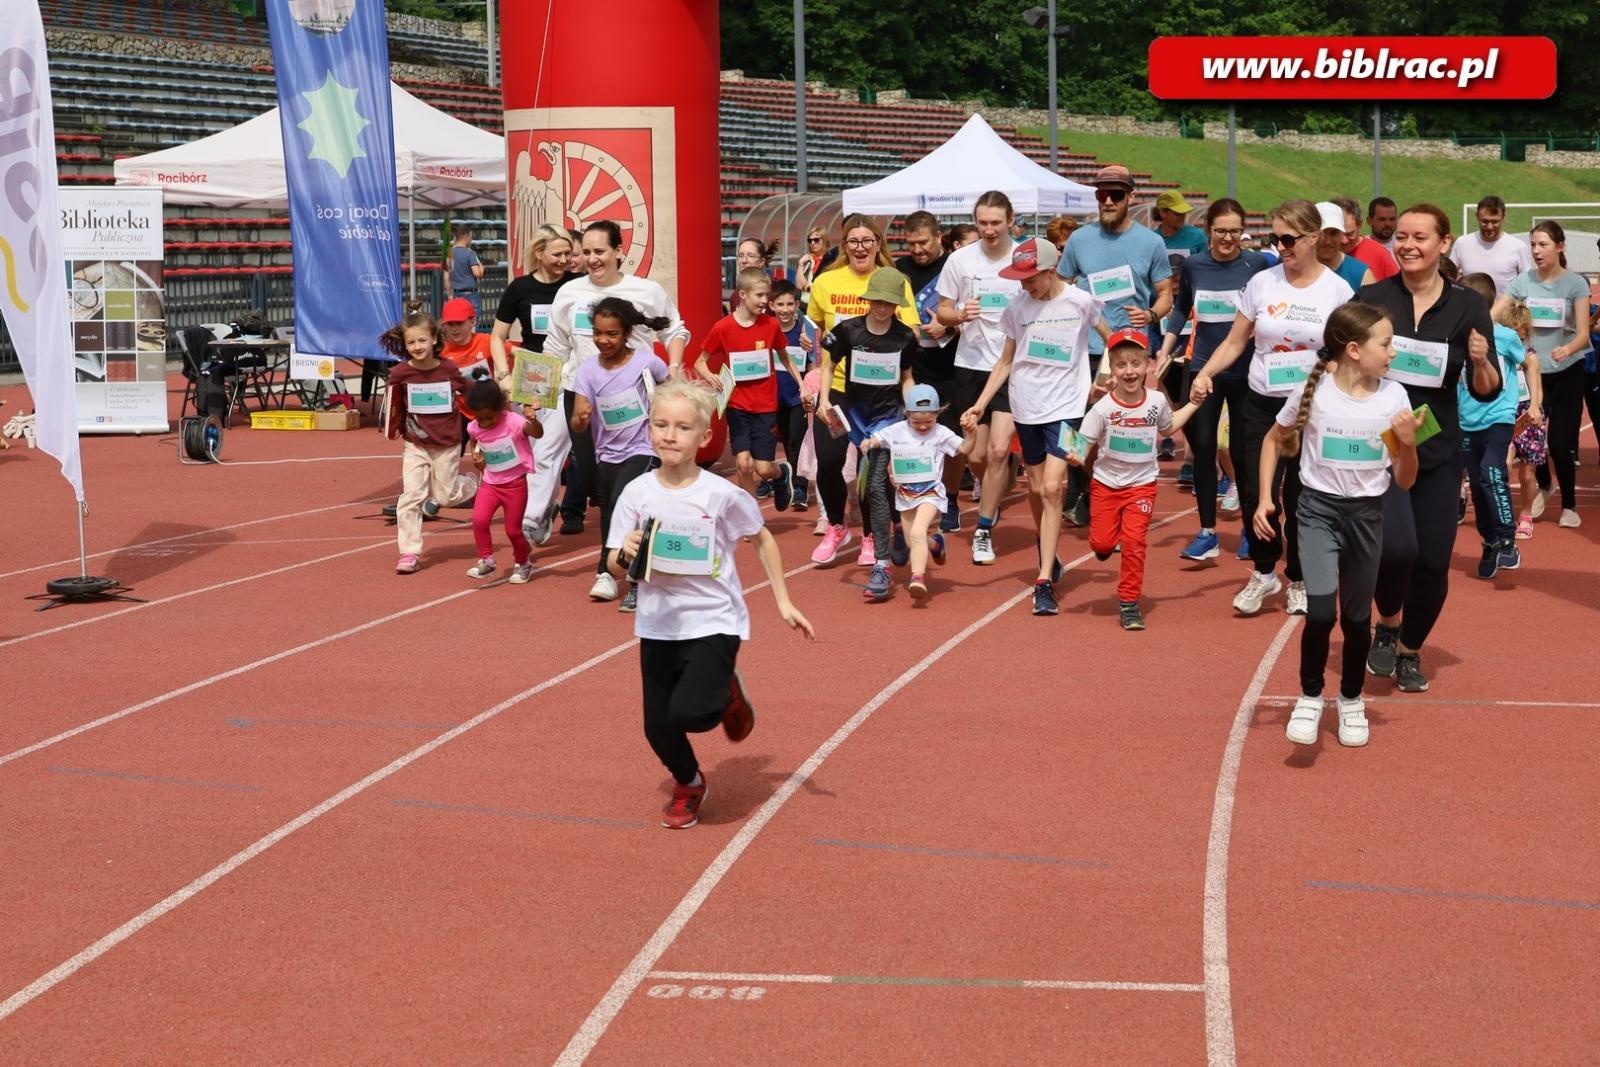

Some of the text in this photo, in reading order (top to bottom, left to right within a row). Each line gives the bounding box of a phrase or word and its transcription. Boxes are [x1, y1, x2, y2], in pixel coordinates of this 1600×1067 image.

[158, 172, 207, 183] Racibórz
[440, 166, 473, 178] Racibórz
[59, 209, 150, 229] Biblioteka
[92, 231, 144, 243] Publiczna
[1045, 347, 1056, 355] 59
[1408, 357, 1420, 368] 26
[1286, 370, 1295, 378] 15
[1127, 441, 1137, 449] 16
[1348, 443, 1360, 454] 19
[665, 539, 683, 552] 38
